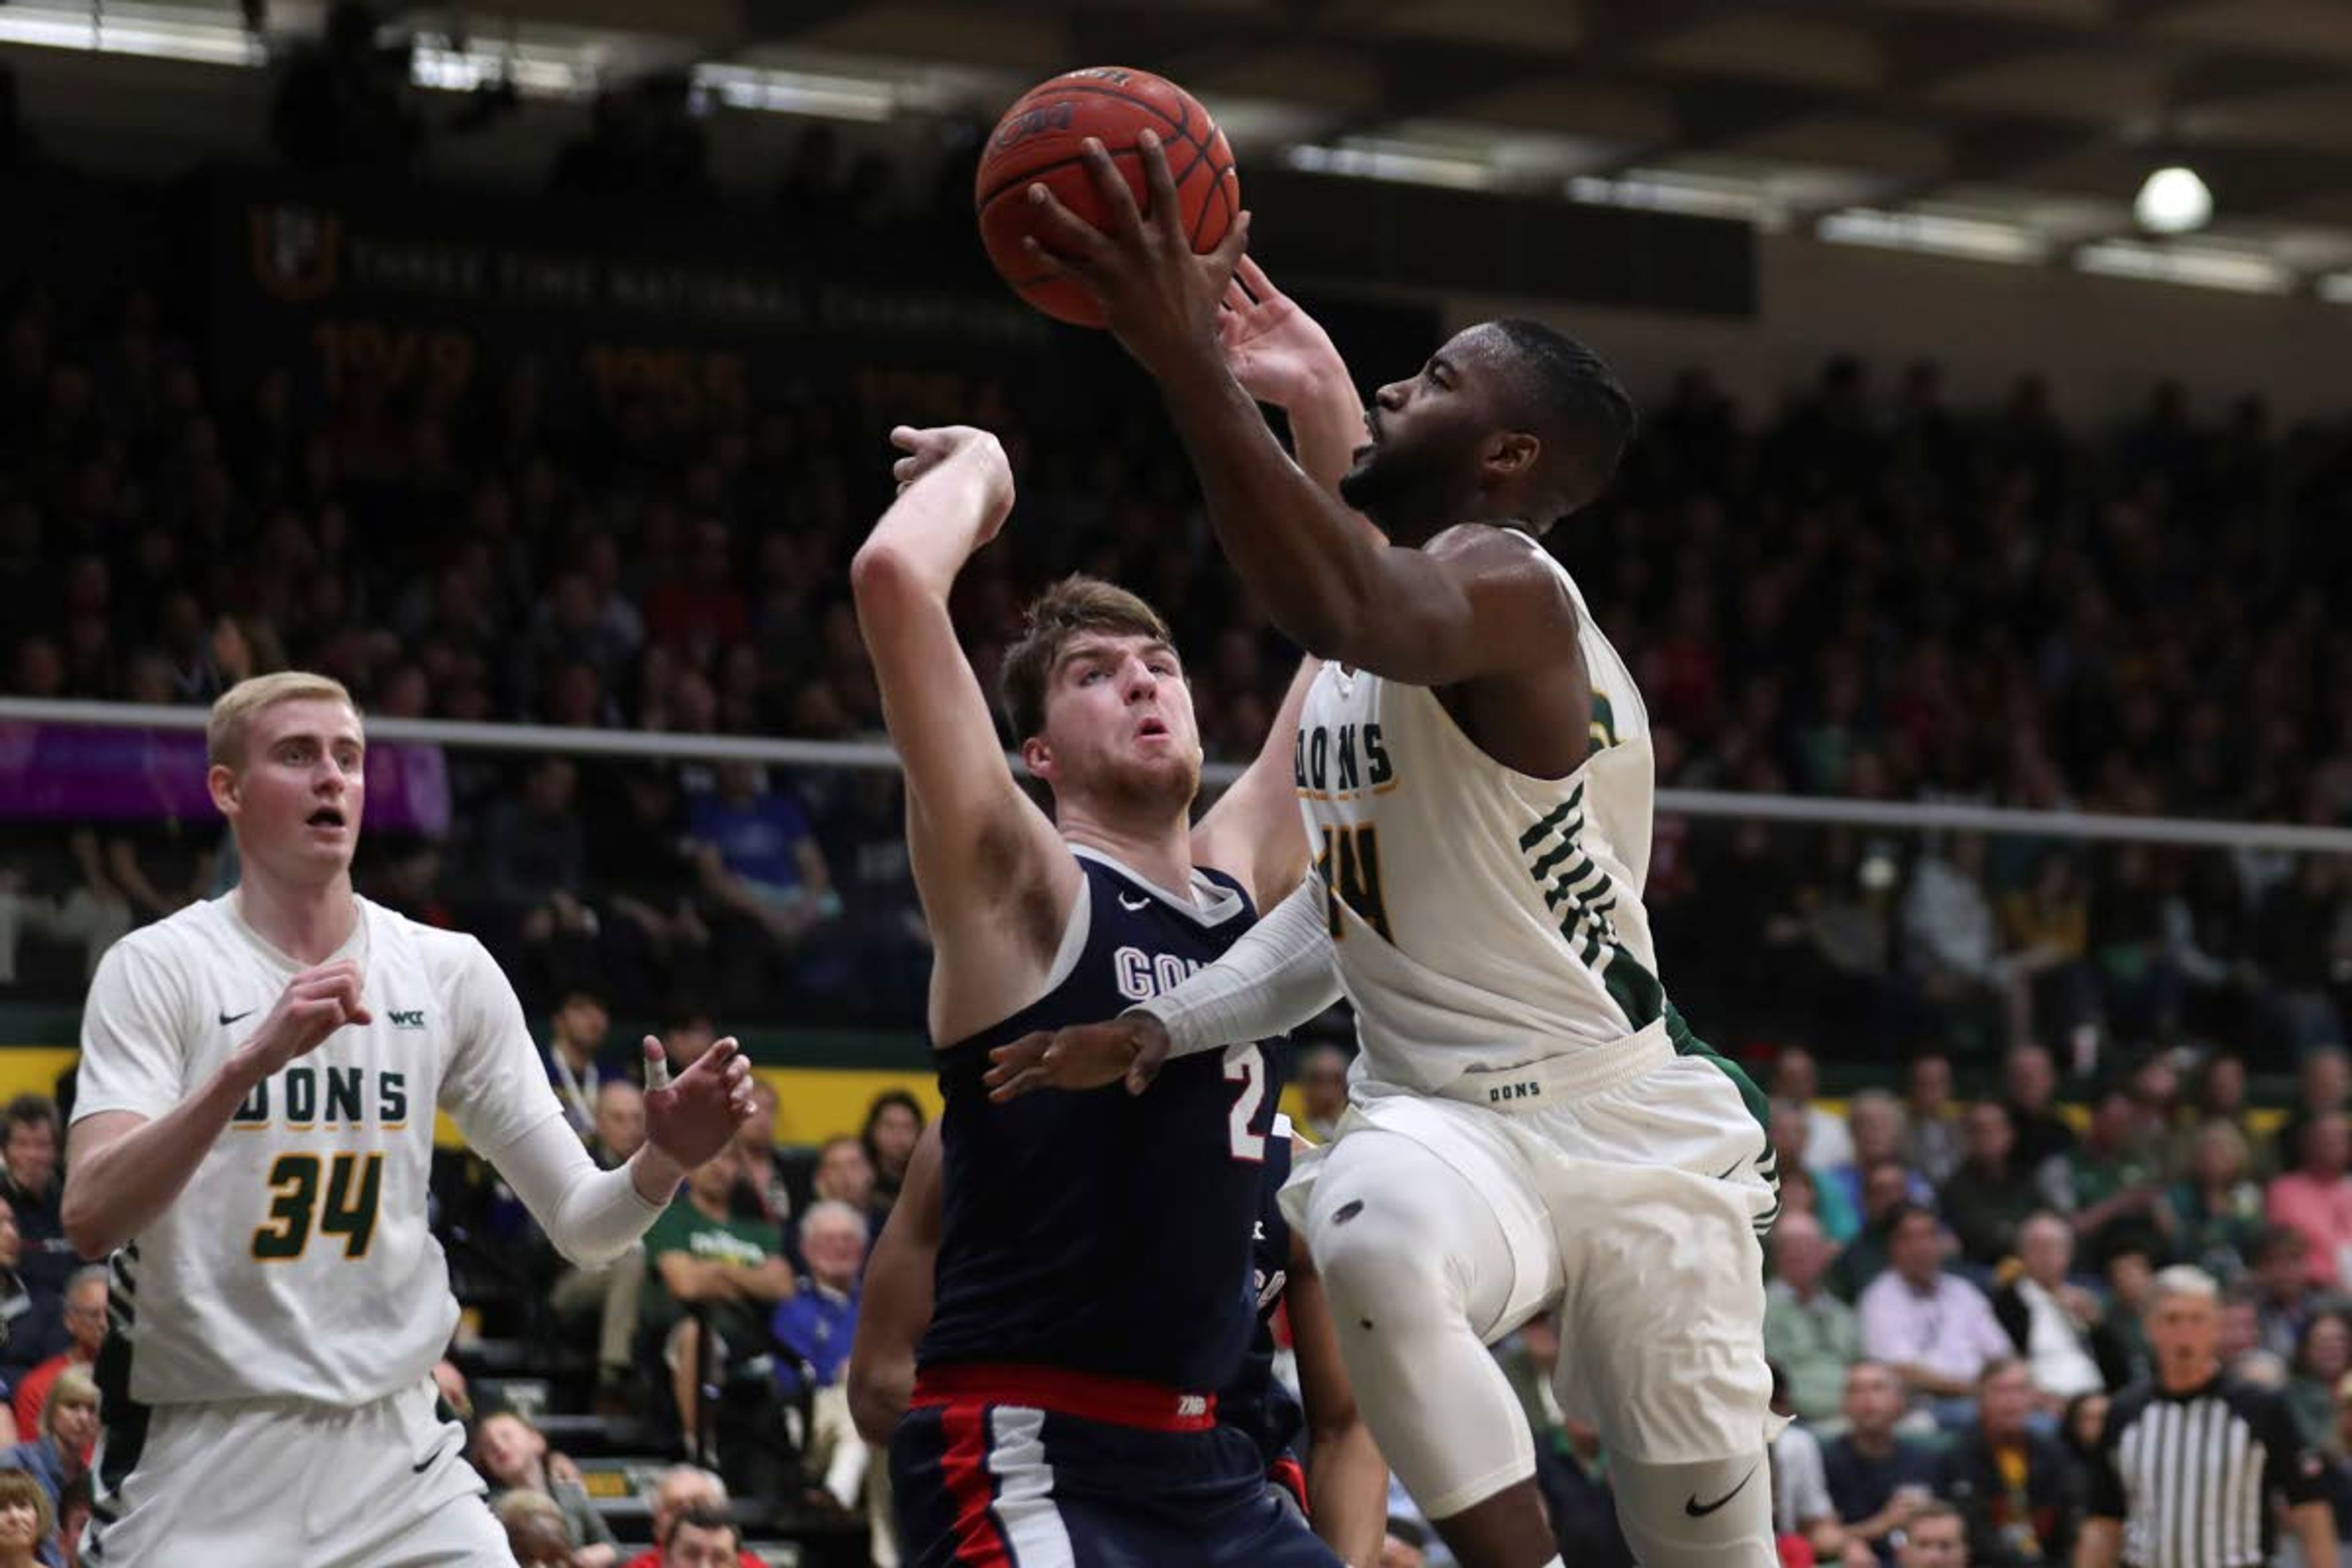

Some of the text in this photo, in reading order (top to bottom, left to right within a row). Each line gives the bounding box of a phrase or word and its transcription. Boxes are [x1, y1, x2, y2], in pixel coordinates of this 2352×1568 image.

[1295, 724, 1392, 790] DONS
[387, 1011, 424, 1027] WCC
[1224, 1041, 1267, 1161] 2
[1490, 1081, 1540, 1102] DONS
[250, 1150, 385, 1263] 34
